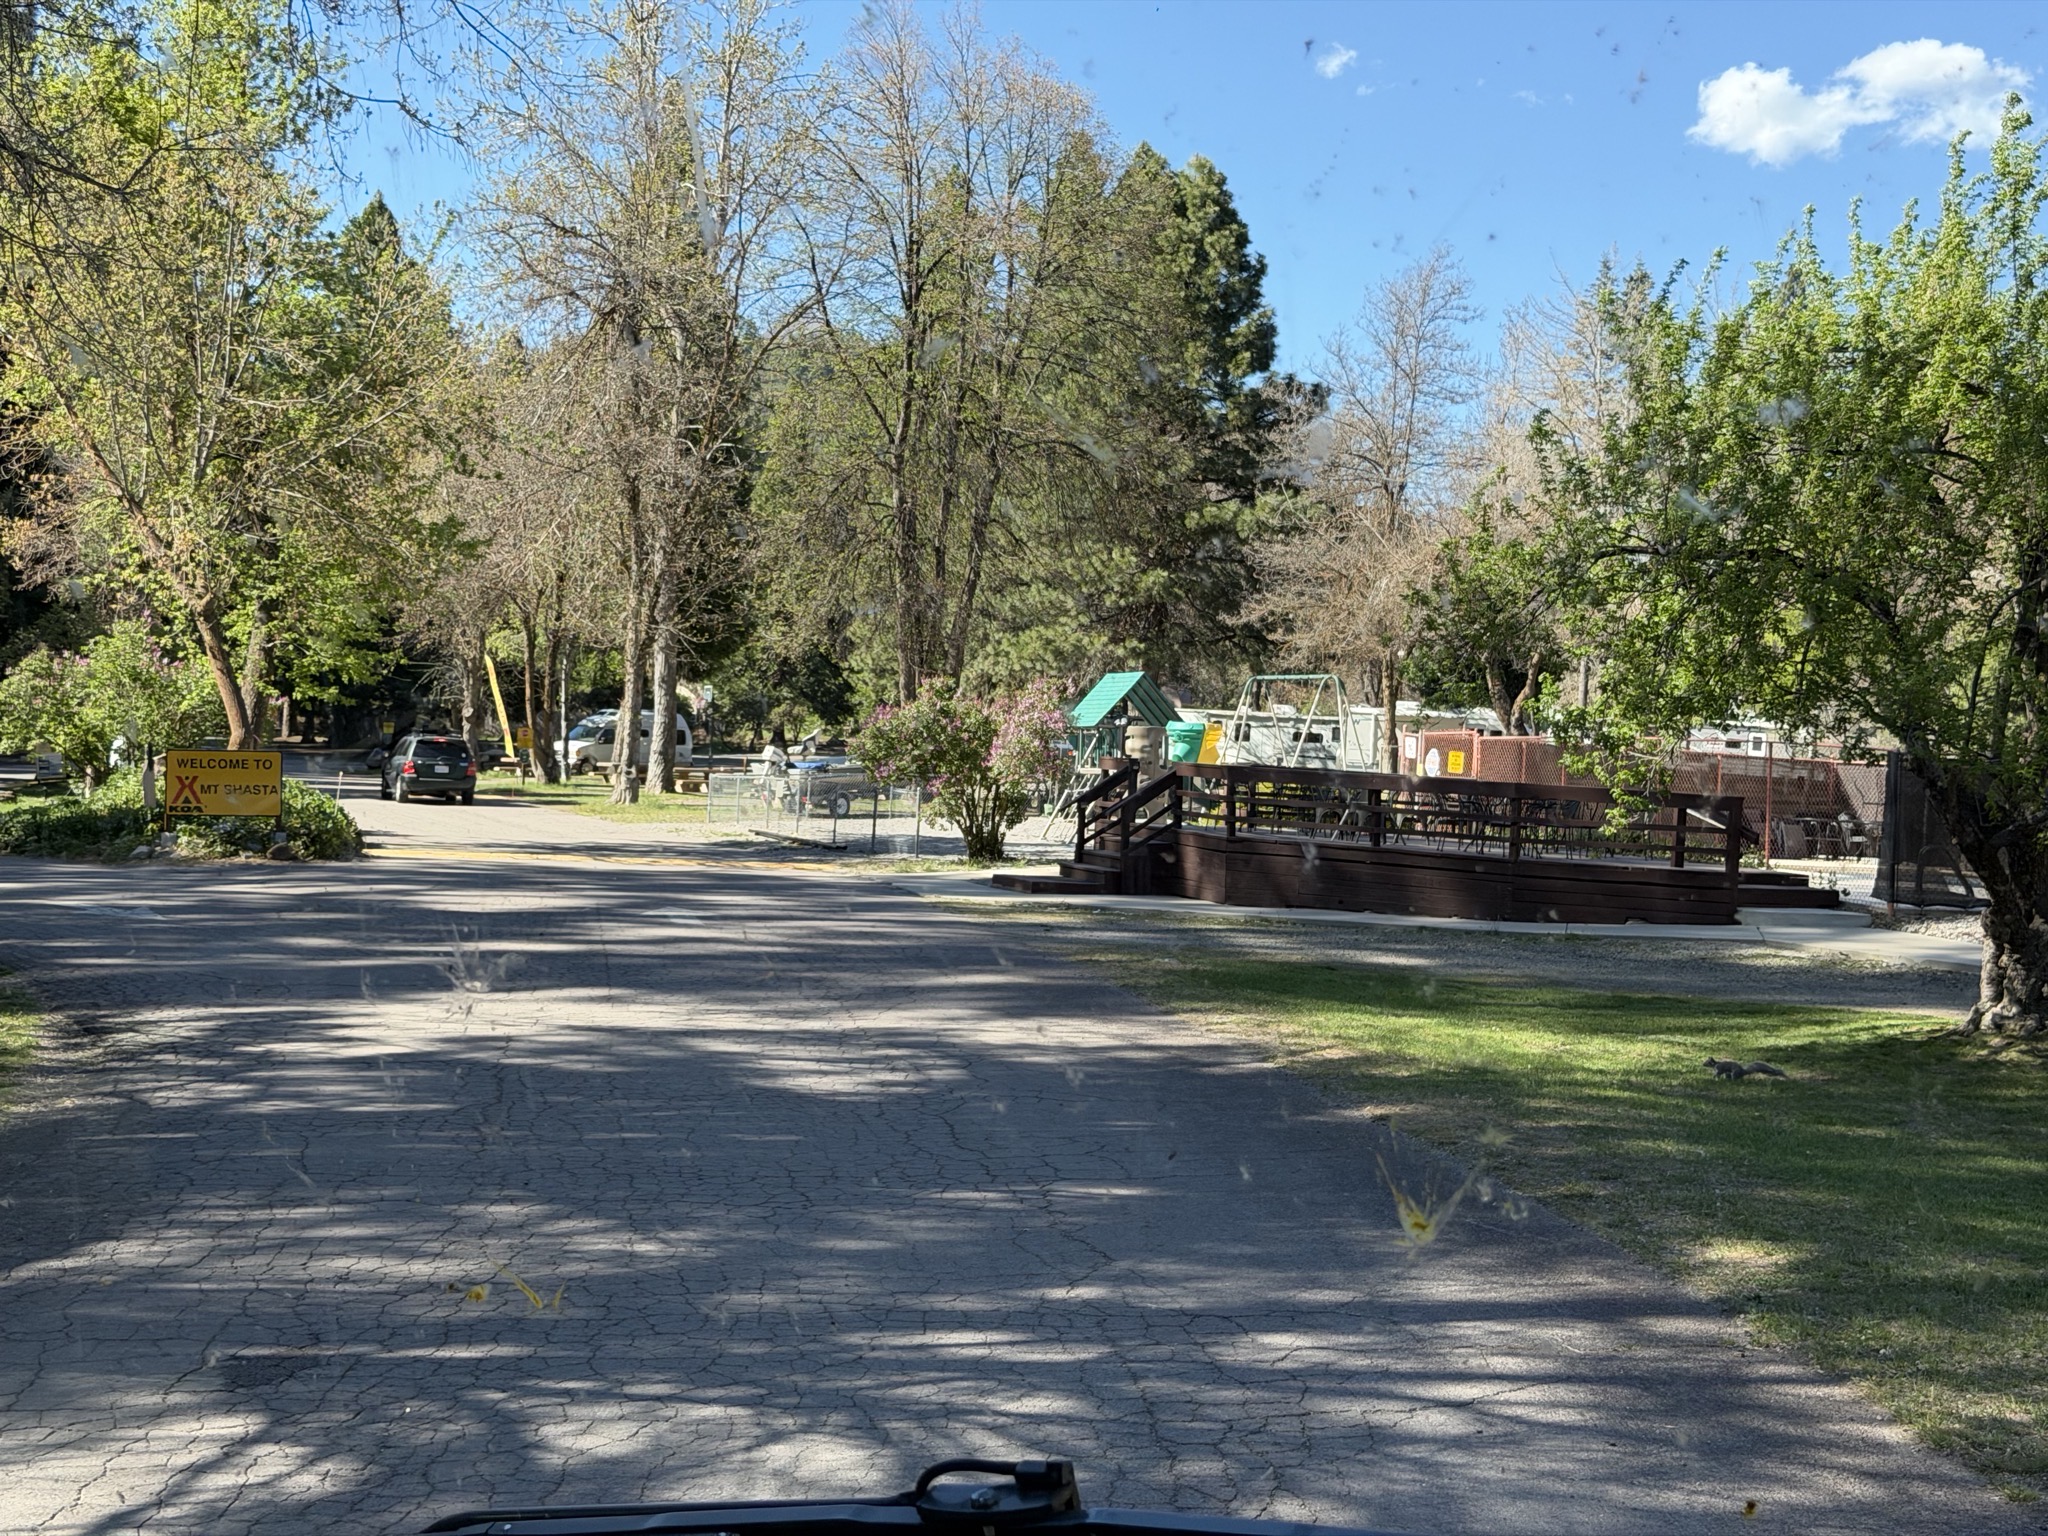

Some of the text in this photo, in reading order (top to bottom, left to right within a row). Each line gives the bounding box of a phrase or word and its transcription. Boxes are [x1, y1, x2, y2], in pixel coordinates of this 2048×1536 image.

[176, 758, 273, 770] WELCOME TO
[200, 784, 279, 795] MT SHASTA
[168, 805, 204, 813] KOA
